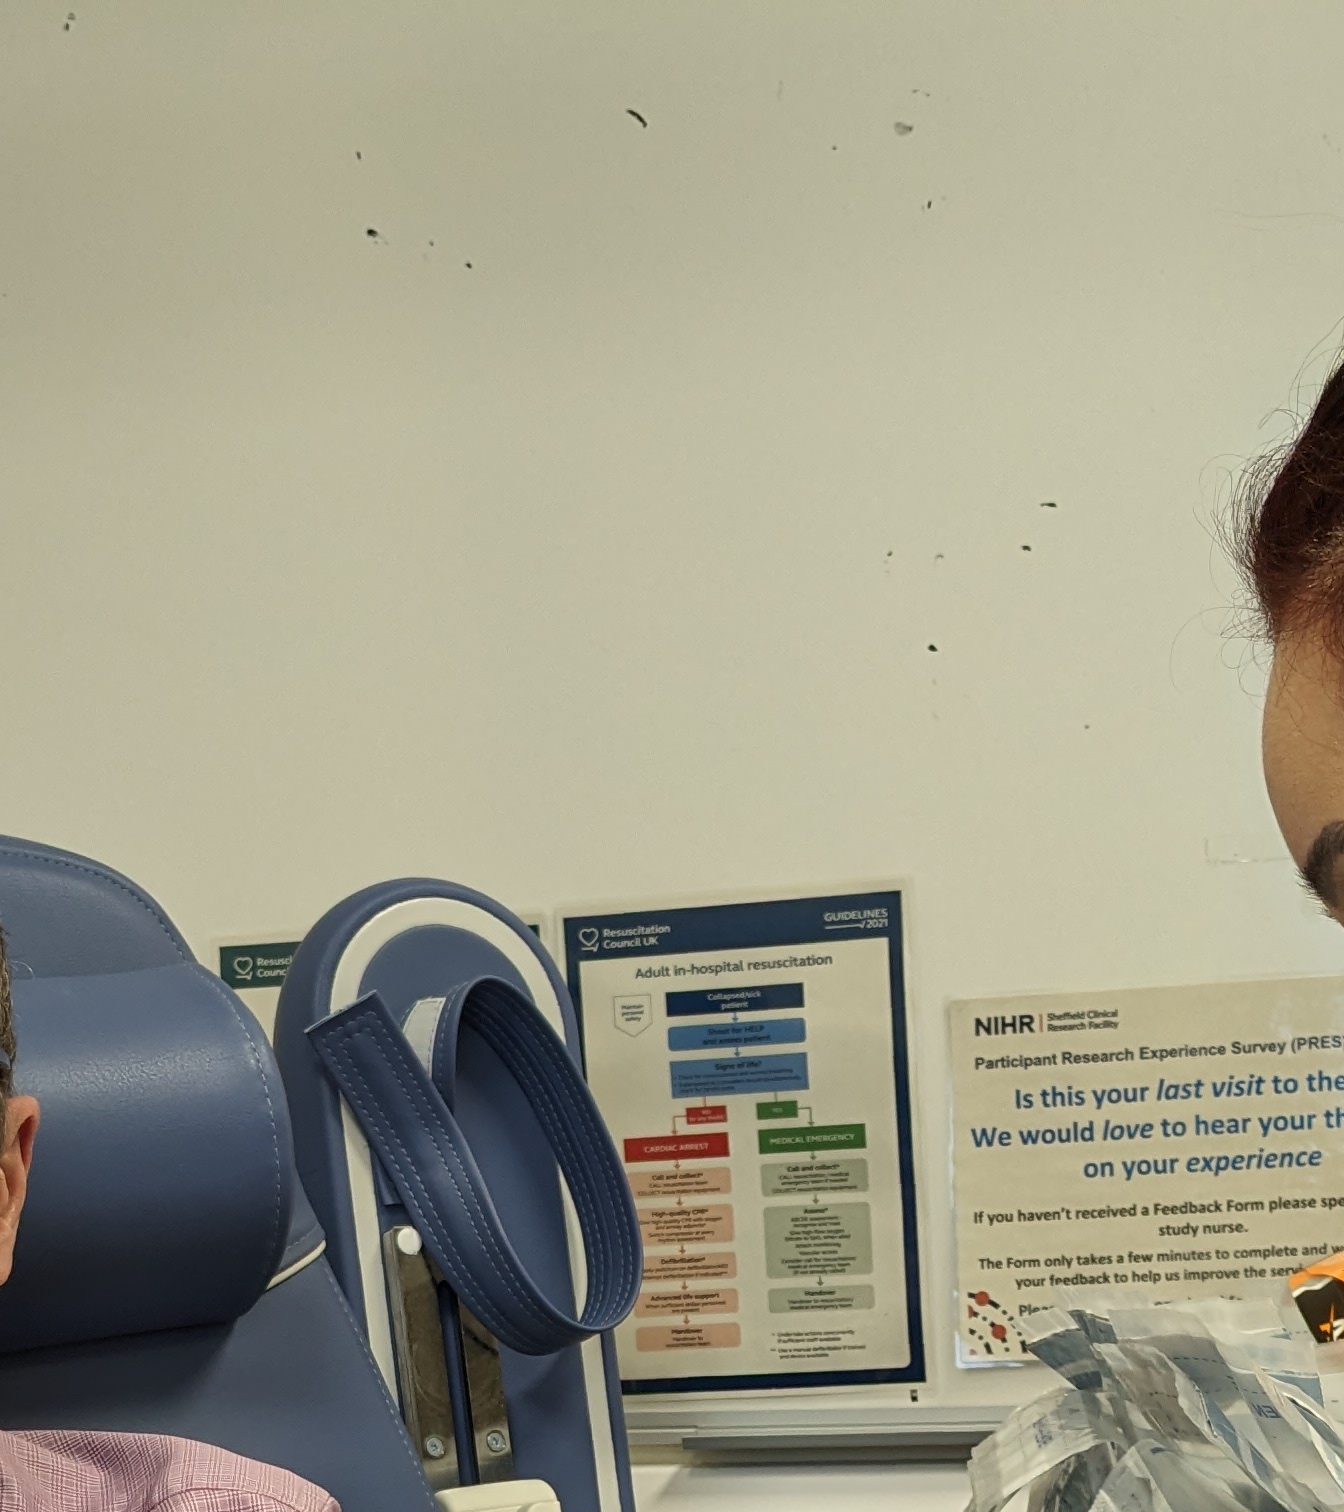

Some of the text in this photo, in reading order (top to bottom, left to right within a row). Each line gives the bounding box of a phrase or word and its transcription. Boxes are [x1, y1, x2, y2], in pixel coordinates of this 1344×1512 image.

[824, 909, 888, 922] GUIDELINES
[604, 924, 671, 938] Resuscitation
[865, 919, 888, 929] 2021
[603, 936, 658, 949] Council UK
[257, 968, 288, 978] Counc
[635, 954, 833, 980] Adult in-hospital resuscitation
[1047, 1009, 1118, 1021] Sheffield Clinical
[974, 1014, 1035, 1036] NIHR
[1047, 1020, 1119, 1032] Research Facility
[974, 1052, 1056, 1070] Participant
[1061, 1048, 1134, 1065] Research
[1139, 1044, 1226, 1062] Experience
[1232, 1041, 1285, 1056] Survey
[1015, 1089, 1035, 1110] Is
[1042, 1084, 1086, 1109] this
[1093, 1084, 1149, 1111] your
[1156, 1078, 1204, 1101] last
[1212, 1073, 1265, 1098] visit
[1272, 1076, 1298, 1095] to
[769, 1133, 855, 1145] MEDICAL EMERGENCY
[971, 1127, 1012, 1148] We
[1020, 1119, 1094, 1145] would
[1103, 1116, 1154, 1141] love
[1161, 1118, 1186, 1137] to
[1195, 1115, 1251, 1135] hear
[1258, 1114, 1317, 1138] your
[644, 1142, 709, 1153] CARDIAC ARREST
[1084, 1146, 1323, 1181] on your experience
[974, 1211, 984, 1224] If
[987, 1212, 1014, 1226] you
[1018, 1207, 1072, 1222] haven't
[1075, 1204, 1137, 1219] received
[1141, 1207, 1150, 1216] a
[1154, 1199, 1223, 1216] Feedback
[1227, 1199, 1264, 1212] Form
[1269, 1196, 1316, 1213] please
[1159, 1222, 1248, 1238] study nurse.
[978, 1258, 1003, 1270] The
[1007, 1256, 1041, 1268] Form
[1044, 1254, 1073, 1269] only
[1076, 1252, 1113, 1266] takes
[1116, 1255, 1125, 1264] a
[1127, 1250, 1153, 1264] few
[1157, 1248, 1212, 1262] minutes
[1215, 1248, 1230, 1260] to
[1233, 1243, 1299, 1262] complete
[1302, 1242, 1328, 1256] and
[1015, 1277, 1046, 1290] your
[1049, 1272, 1111, 1287] feedback
[1113, 1272, 1128, 1284] to
[1131, 1270, 1161, 1285] help
[1165, 1271, 1180, 1282] us
[1183, 1267, 1240, 1284] improve
[1244, 1264, 1267, 1278] the
